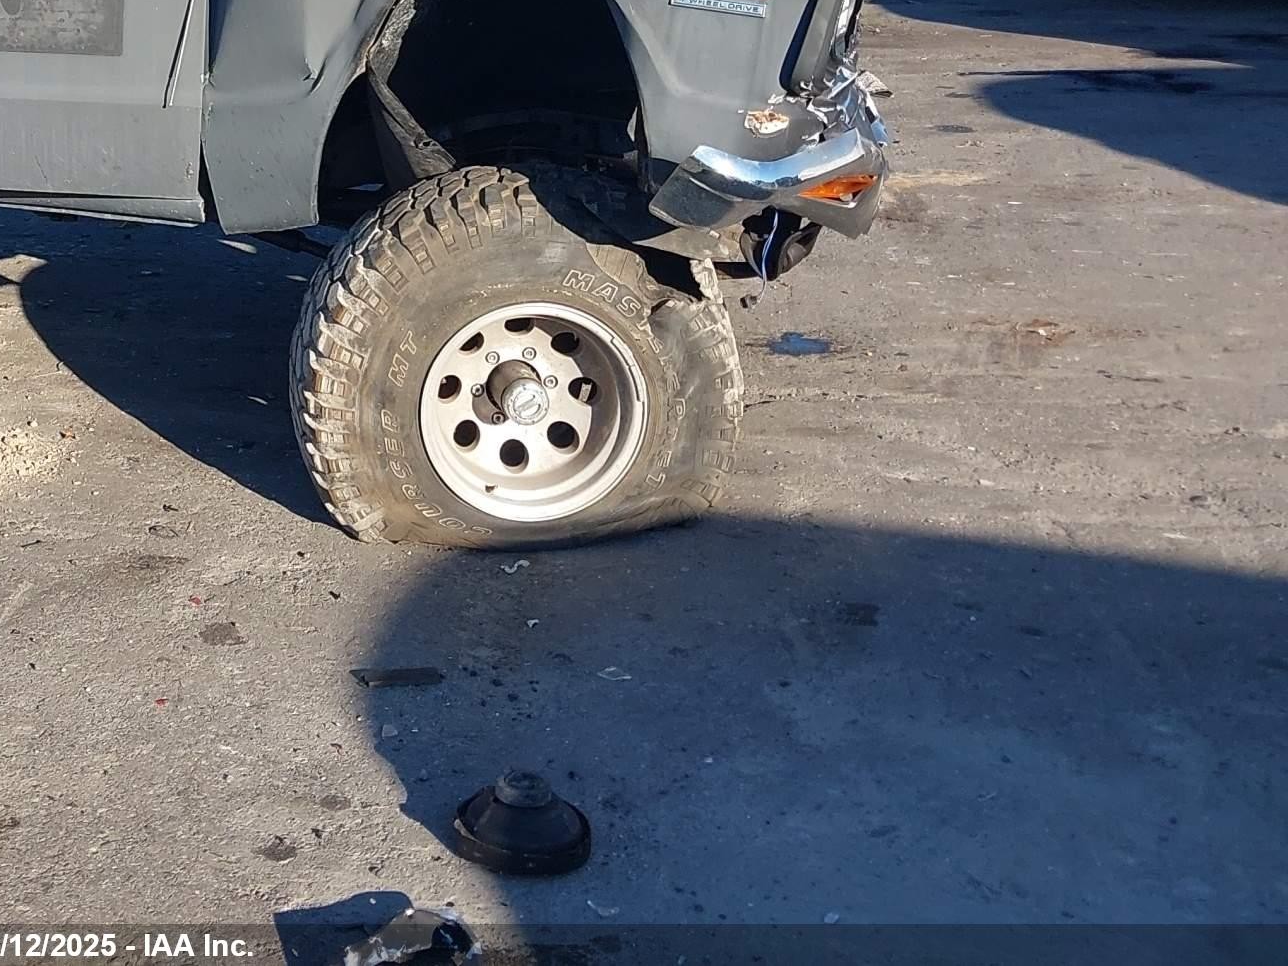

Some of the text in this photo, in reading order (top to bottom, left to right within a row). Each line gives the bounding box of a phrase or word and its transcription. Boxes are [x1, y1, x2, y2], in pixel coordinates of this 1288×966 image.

[727, 3, 759, 13] DRIVE
[388, 330, 417, 388] MT
[380, 409, 493, 536] COURSER
